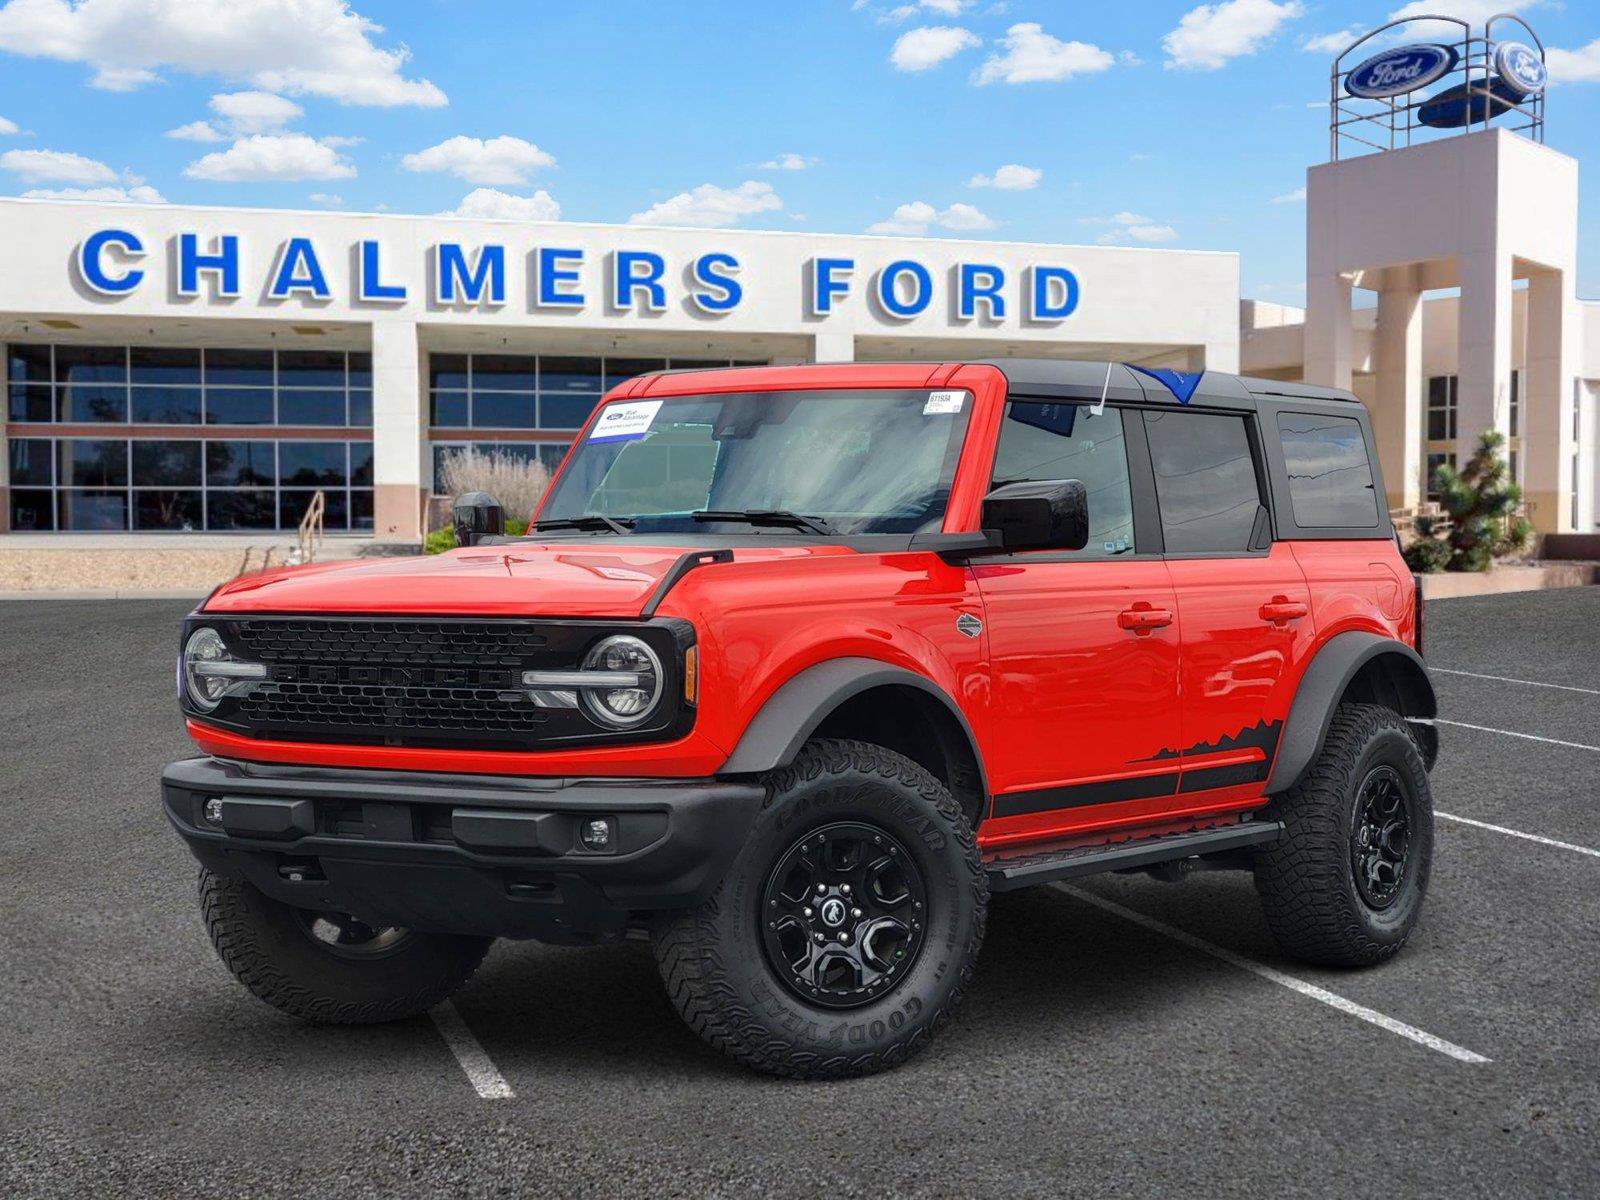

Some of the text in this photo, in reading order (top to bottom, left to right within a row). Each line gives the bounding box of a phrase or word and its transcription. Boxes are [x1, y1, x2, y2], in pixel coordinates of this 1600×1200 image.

[1367, 56, 1423, 87] Ford
[79, 227, 1082, 321] CHALMERS FORD
